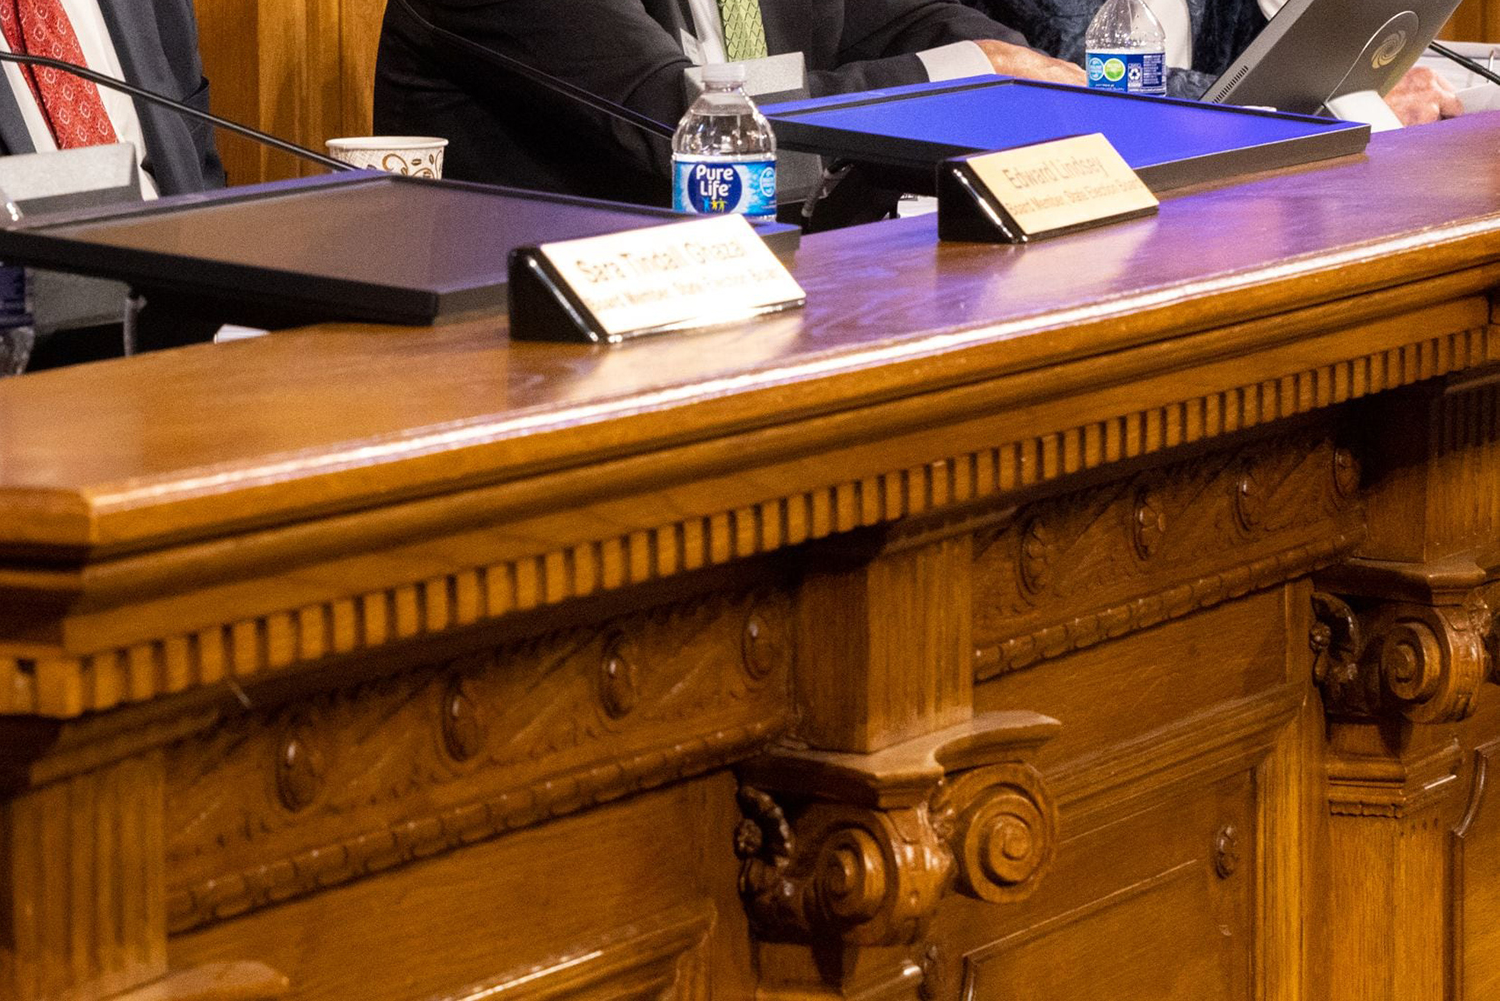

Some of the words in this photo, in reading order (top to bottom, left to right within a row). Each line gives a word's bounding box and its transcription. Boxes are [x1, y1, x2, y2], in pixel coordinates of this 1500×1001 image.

[696, 164, 734, 181] Pure
[1003, 161, 1060, 189] Edward
[1049, 156, 1109, 179] Lindsey
[700, 180, 729, 200] Life
